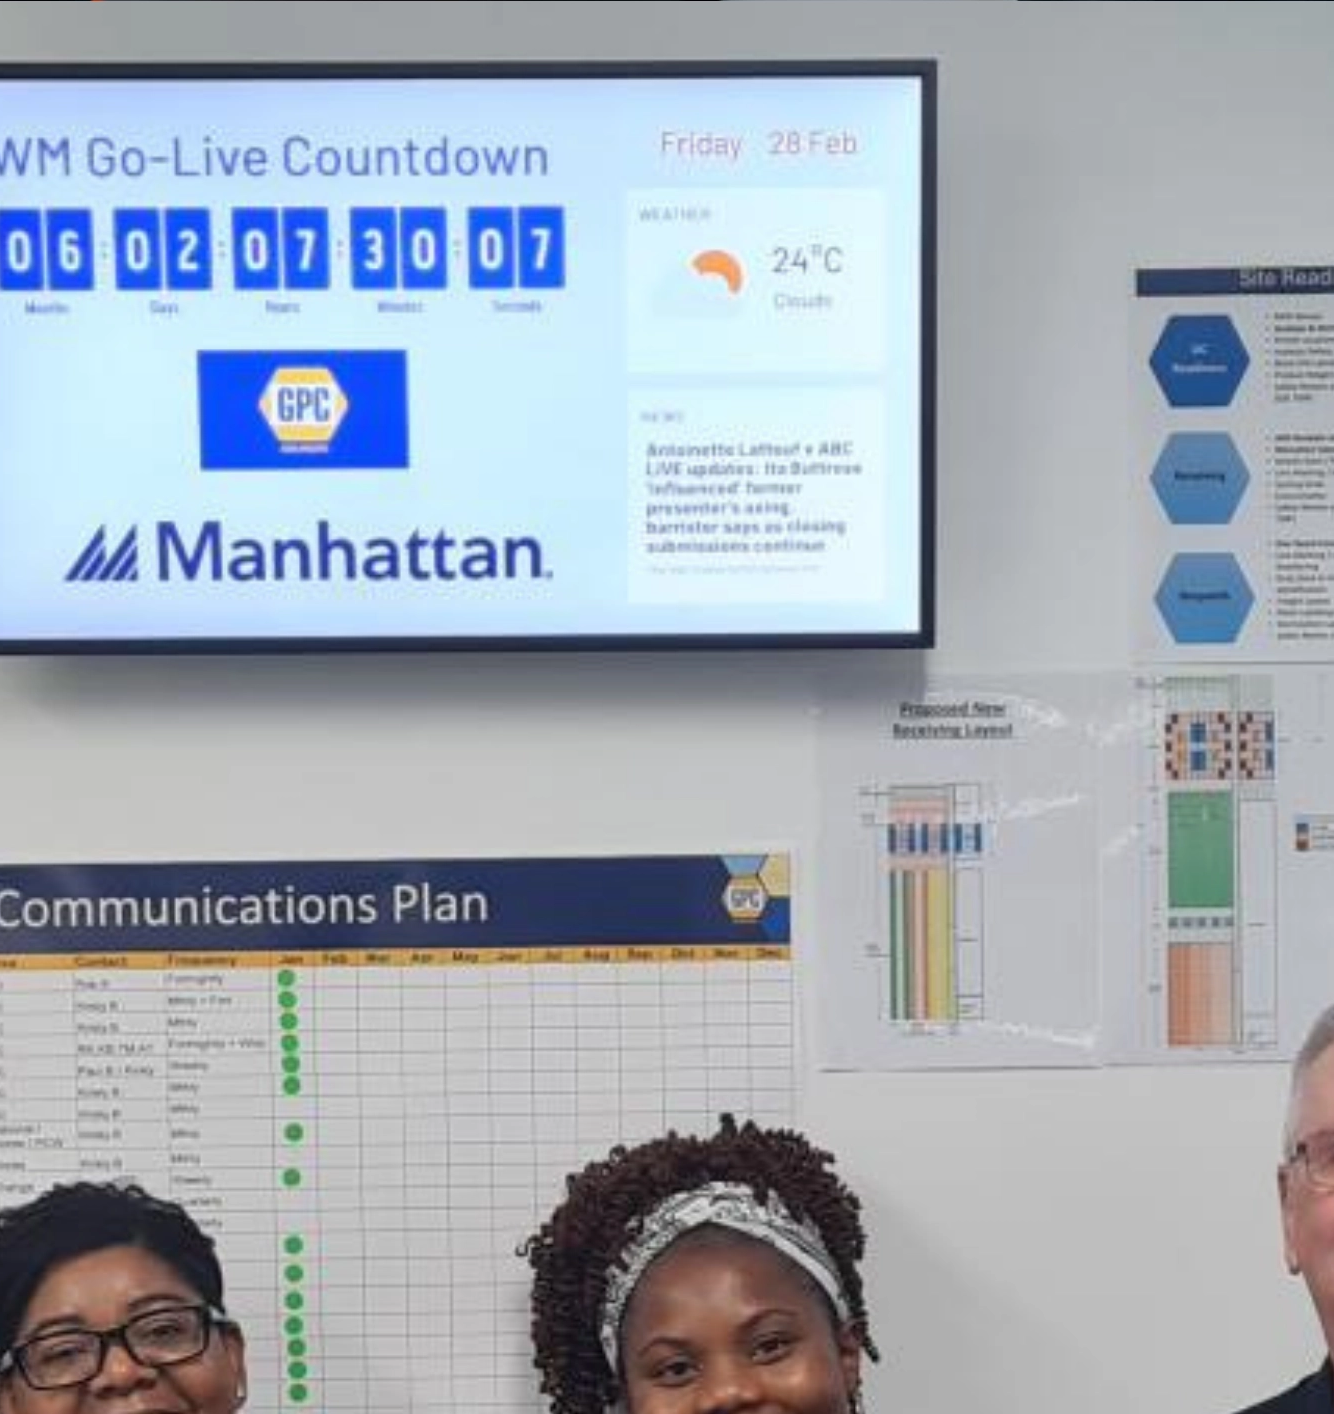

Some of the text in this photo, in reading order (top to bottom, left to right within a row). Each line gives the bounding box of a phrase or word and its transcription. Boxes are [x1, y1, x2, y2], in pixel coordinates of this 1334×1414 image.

[87, 136, 268, 177] Go-Live
[282, 135, 549, 176] Countdown
[661, 130, 857, 159] Friday 28 Feb
[6, 229, 553, 271] 06 02 07 30 07
[1239, 268, 1274, 287] Site
[277, 387, 330, 422] GPC
[819, 441, 853, 456] ABC
[899, 701, 1006, 720] Proposed New
[892, 723, 1012, 740] Receiving Layout
[393, 882, 488, 923] Plan
[168, 953, 237, 968] Frequency
